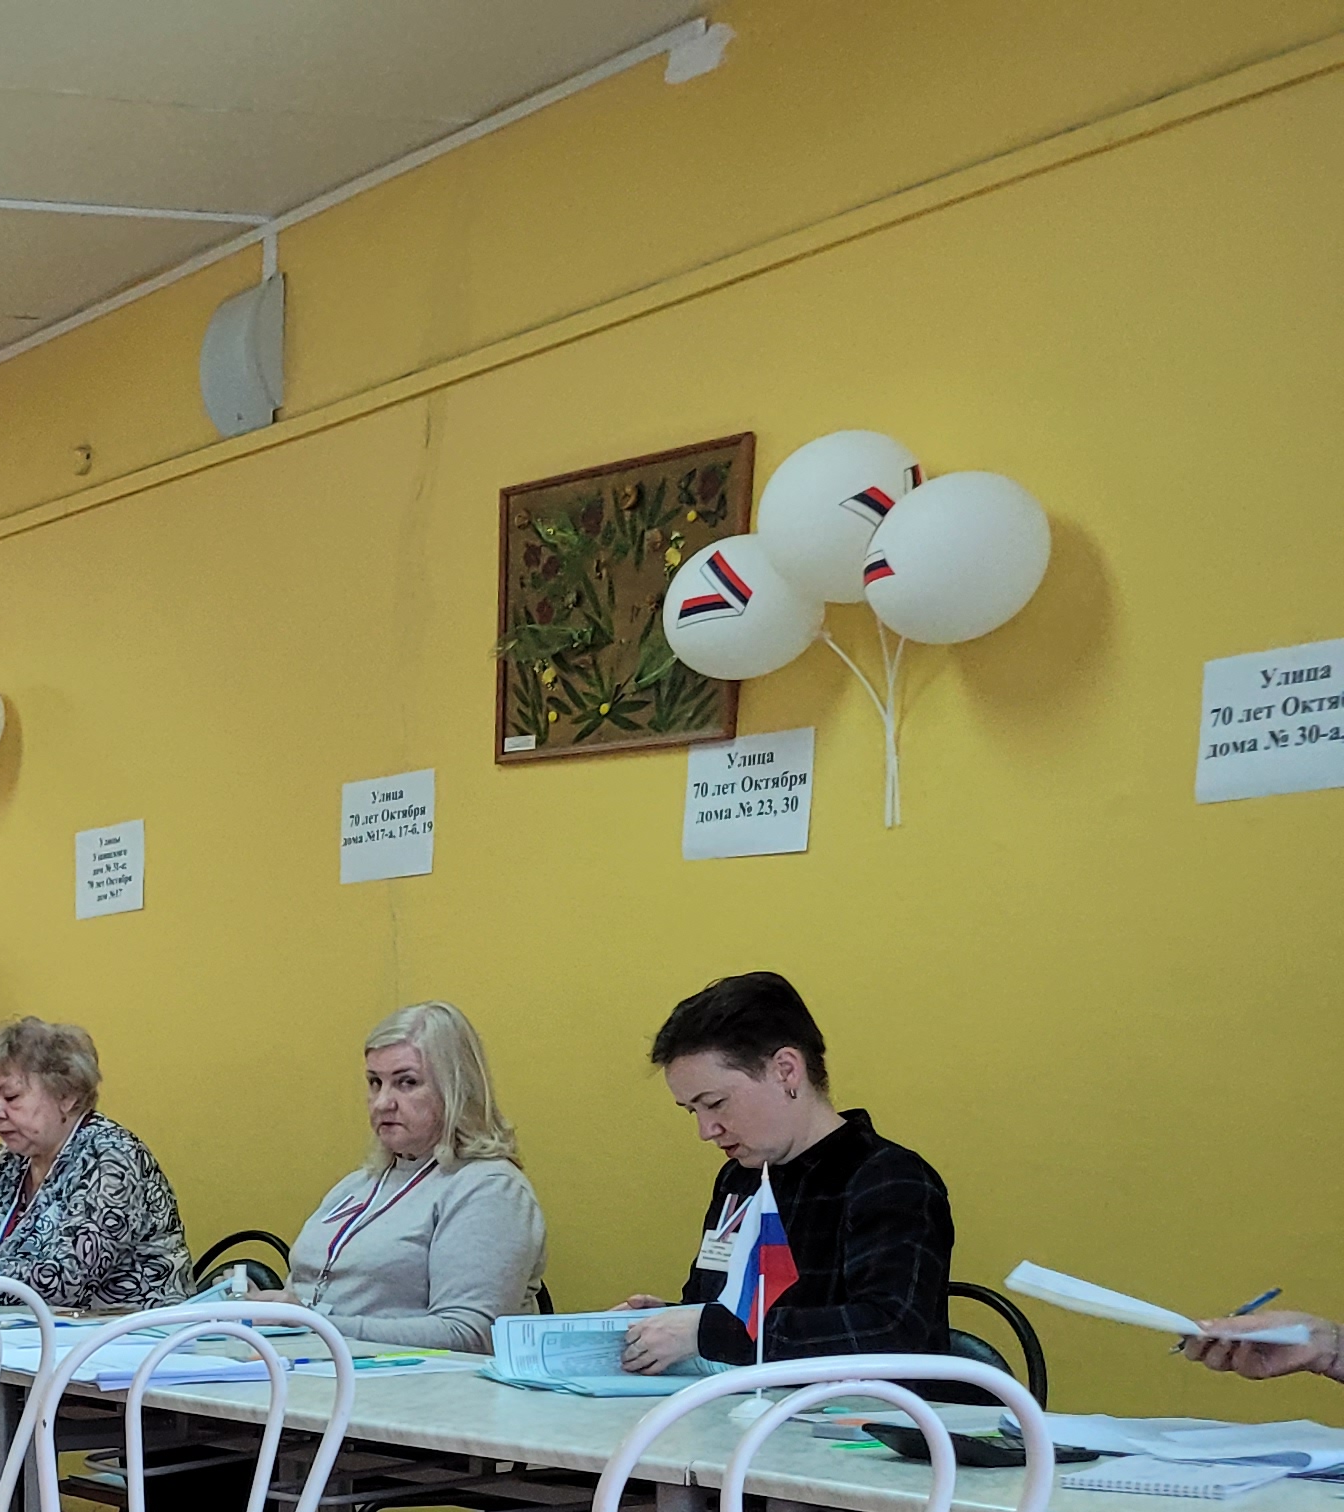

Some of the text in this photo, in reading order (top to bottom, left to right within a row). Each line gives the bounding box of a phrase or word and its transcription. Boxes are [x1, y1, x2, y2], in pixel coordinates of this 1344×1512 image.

[1260, 664, 1332, 689] Улица
[1210, 691, 1344, 728] 70 лет Октя
[1205, 738, 1258, 760] дома
[1263, 729, 1289, 750] №
[727, 751, 775, 769] Улица
[371, 789, 404, 804] Улица
[693, 770, 807, 799] 70 лет Октября
[349, 804, 426, 827] 70 лет Октября
[695, 795, 799, 825] дома № 23, 30
[342, 834, 364, 847] дома
[422, 820, 433, 834] 19
